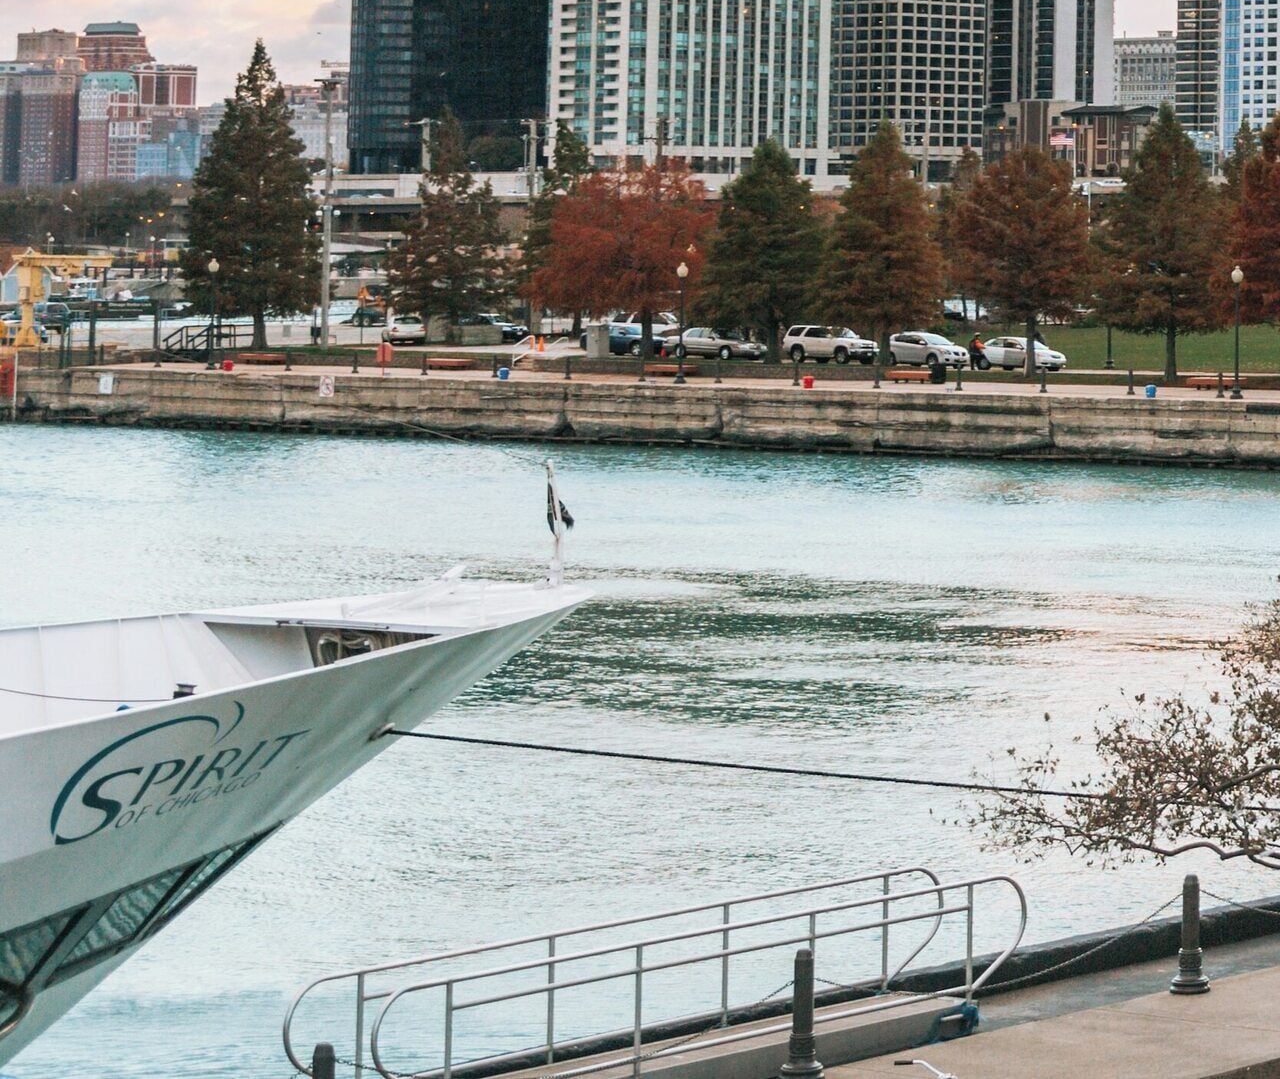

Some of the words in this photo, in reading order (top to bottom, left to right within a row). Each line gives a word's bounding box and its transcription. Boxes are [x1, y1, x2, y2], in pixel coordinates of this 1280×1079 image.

[54, 728, 312, 846] SPIRIT
[114, 804, 153, 829] OF
[155, 771, 262, 817] CHICAGO
